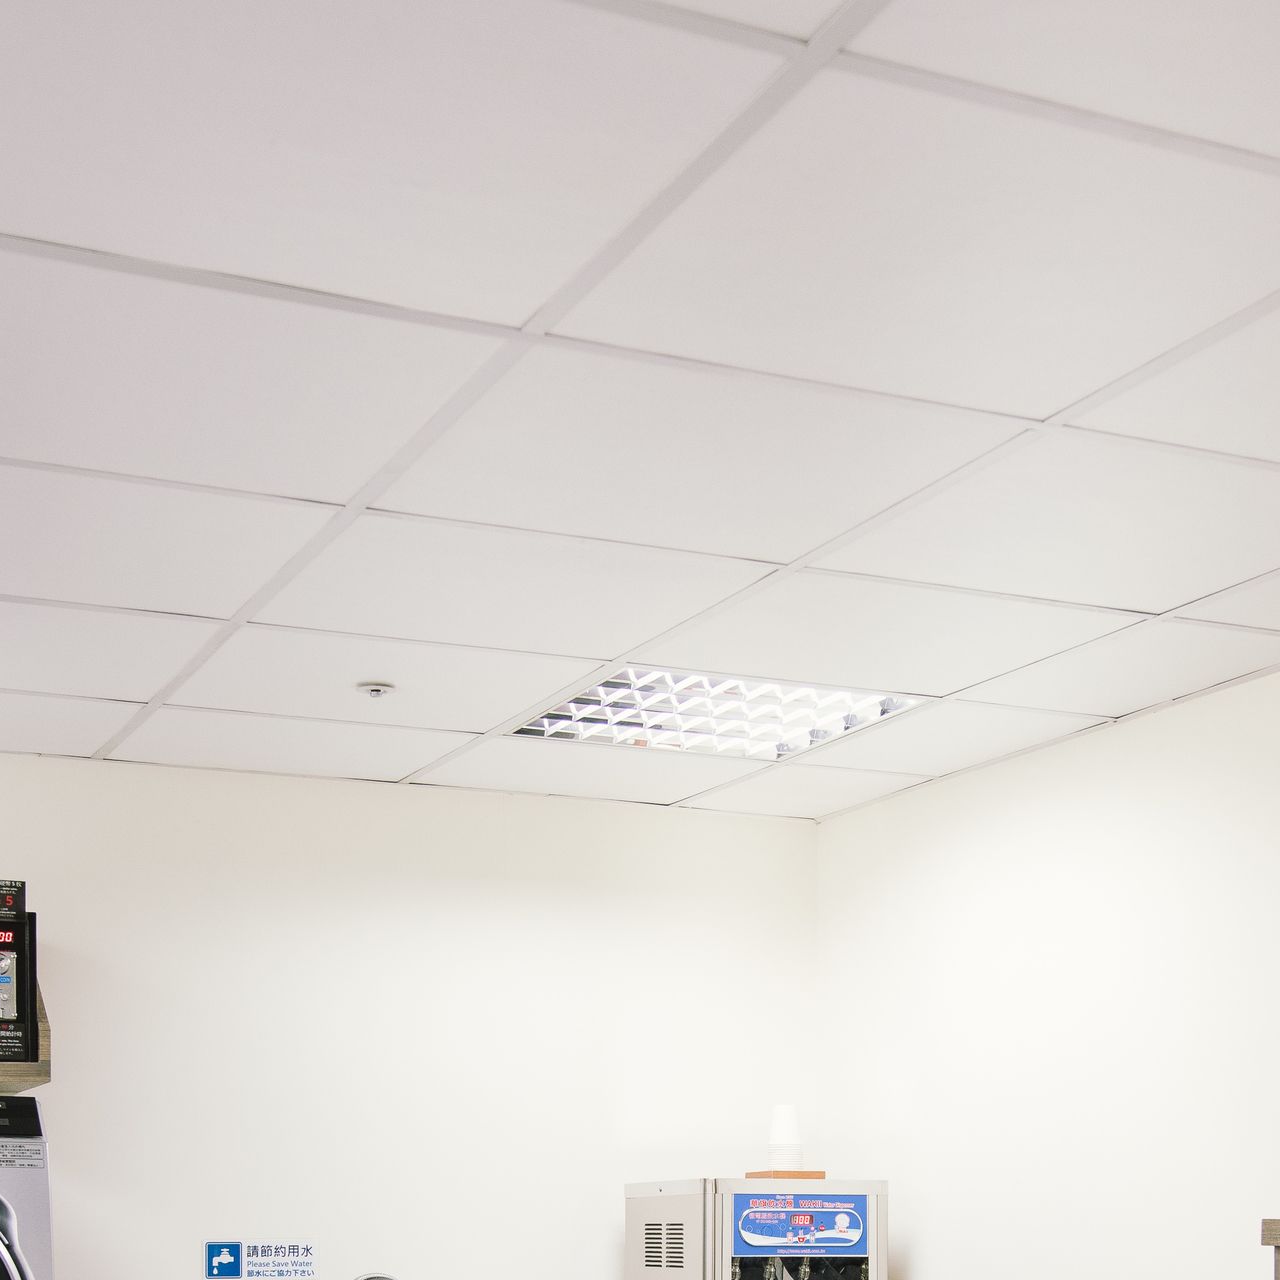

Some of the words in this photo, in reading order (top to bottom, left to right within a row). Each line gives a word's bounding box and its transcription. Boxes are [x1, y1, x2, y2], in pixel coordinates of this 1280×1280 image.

[246, 1244, 313, 1258] 請節約用水
[247, 1260, 271, 1268] Please
[272, 1260, 290, 1268] Save
